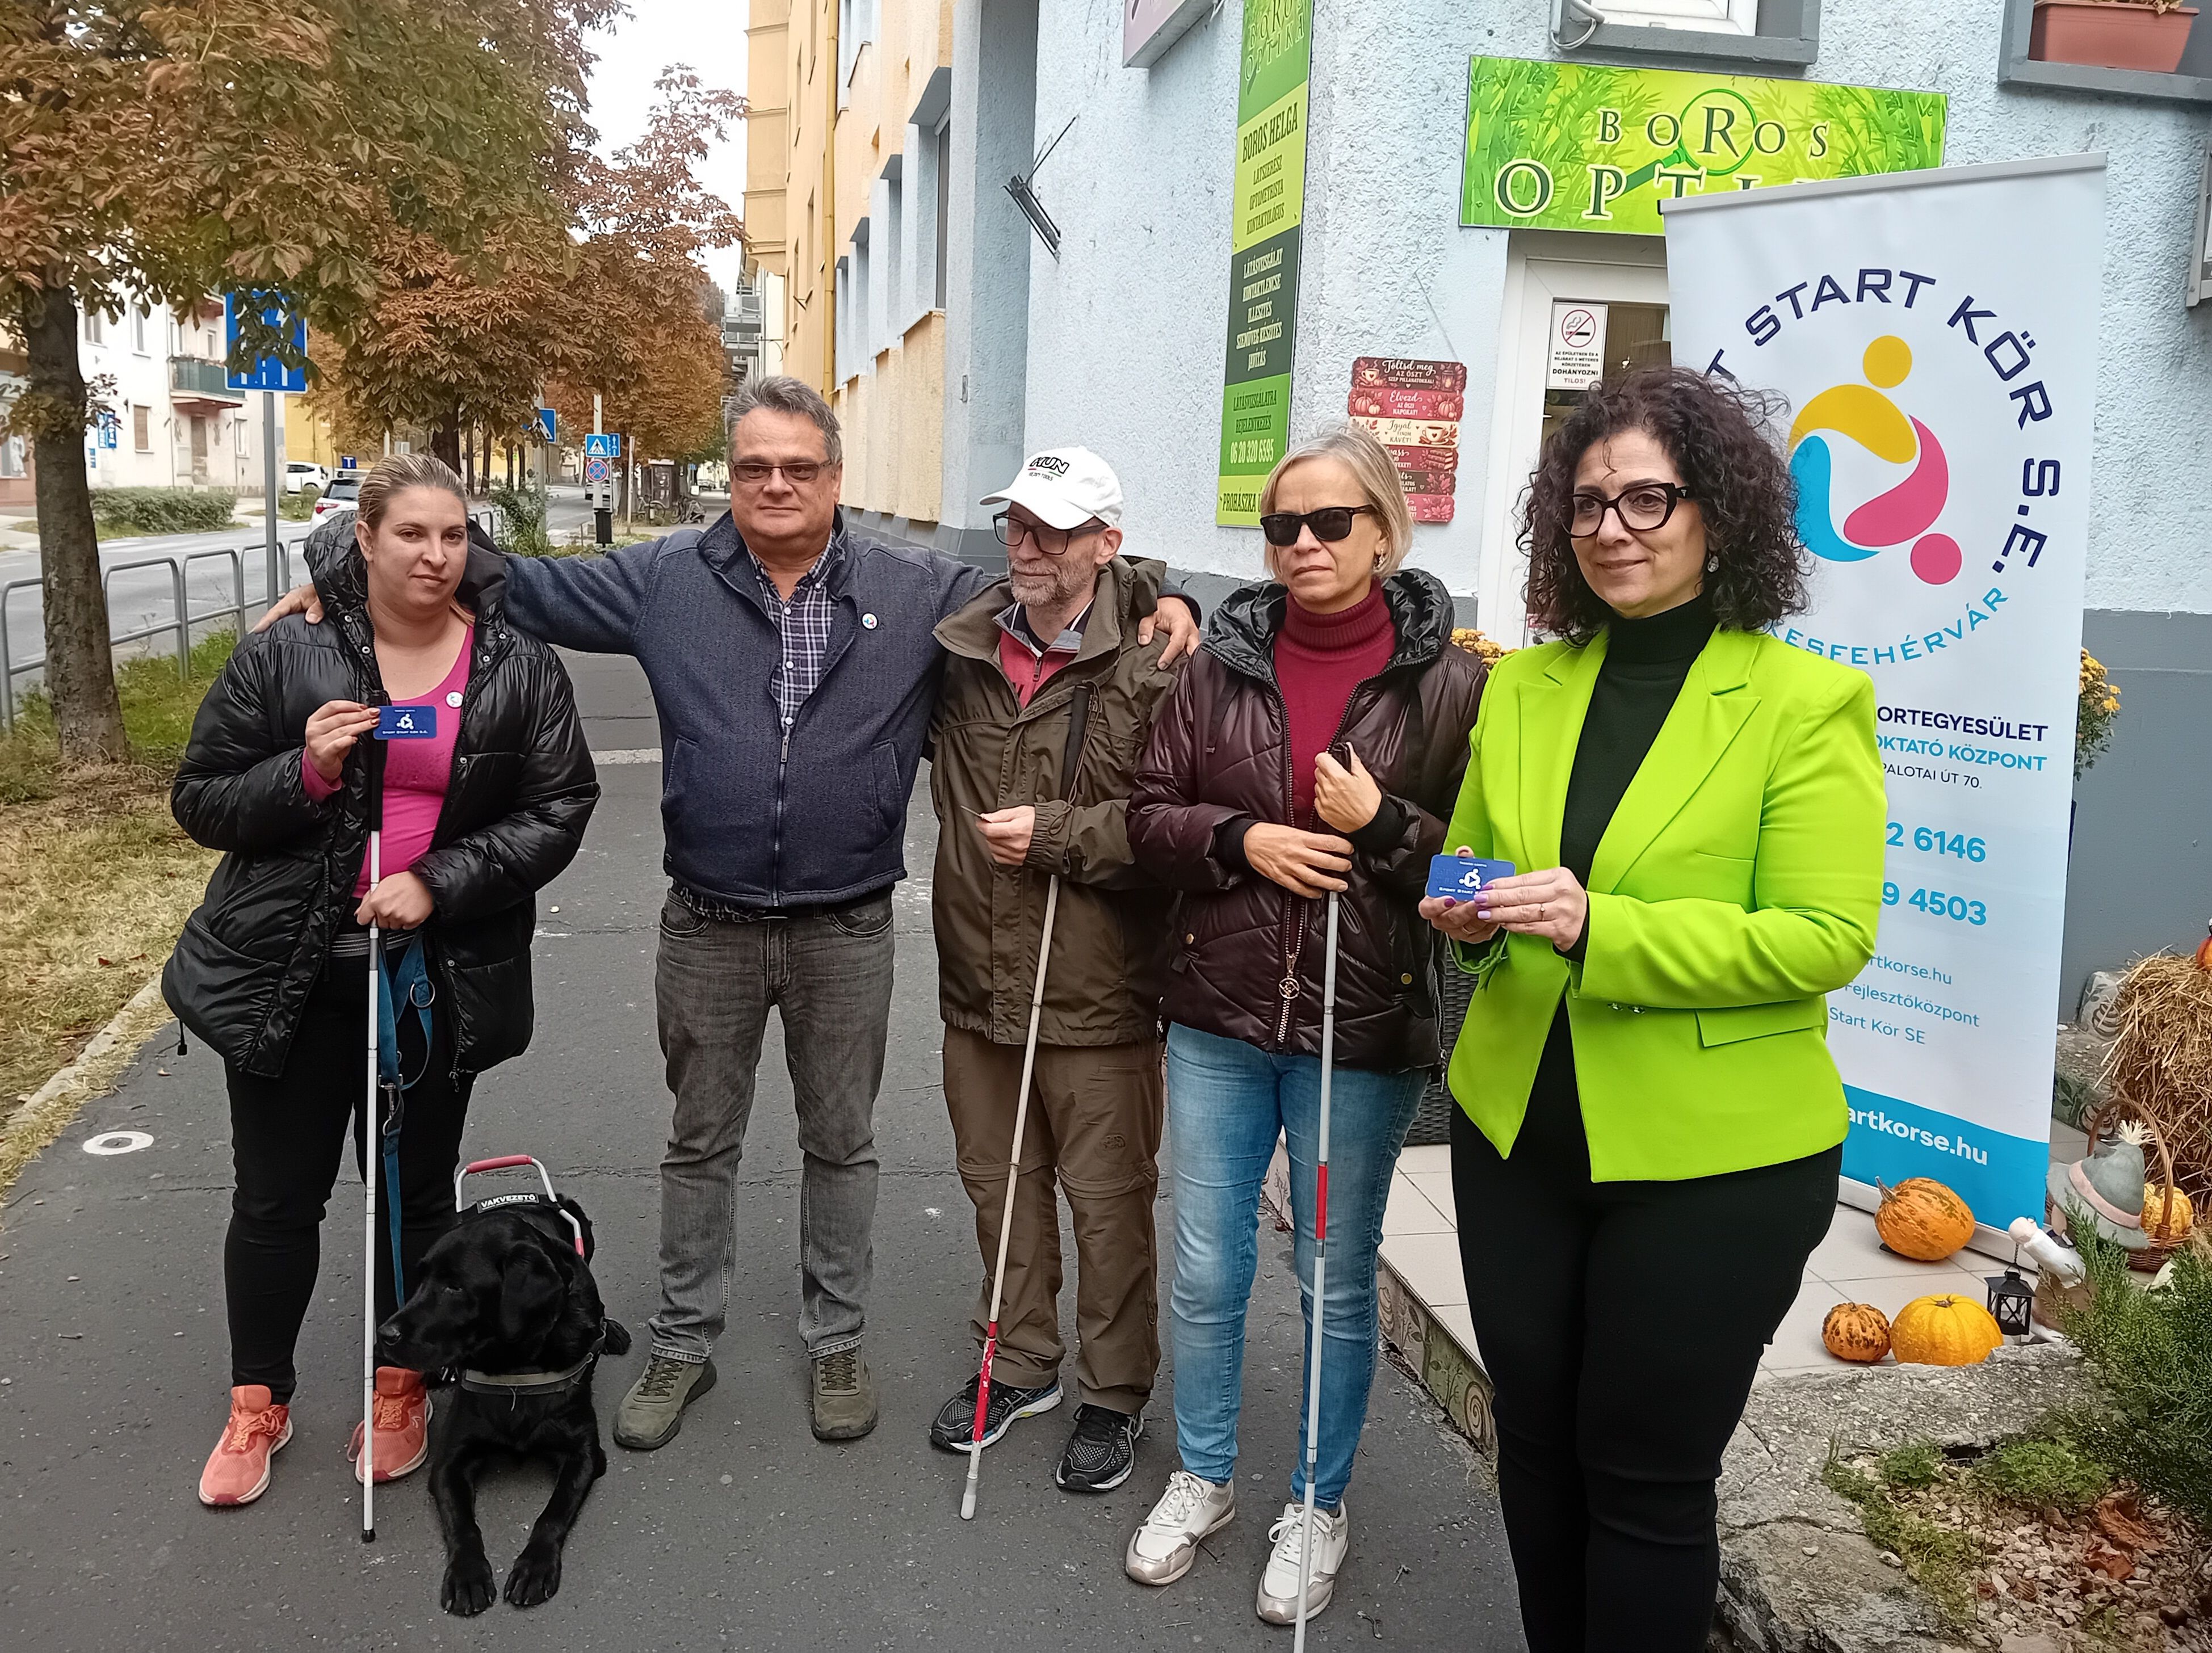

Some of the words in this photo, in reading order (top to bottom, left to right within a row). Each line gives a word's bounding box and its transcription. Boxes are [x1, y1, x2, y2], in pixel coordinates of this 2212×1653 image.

[1245, 12, 1304, 81] OPTIKA
[1242, 122, 1268, 163] BOROS
[1269, 102, 1298, 146] HELGA
[1596, 104, 1830, 159] BOROS
[1744, 268, 1937, 347] START
[1382, 360, 1415, 373] Töltsd
[1416, 364, 1437, 376] meg
[1947, 295, 2052, 431] KÖR
[343, 457, 354, 468] T
[1230, 441, 1238, 464] 06
[1238, 440, 1246, 463] 20
[1246, 440, 1258, 463] 320
[1258, 438, 1274, 462] 6595
[1222, 487, 1256, 512] PROHÁSZKA
[1992, 458, 2060, 573] S.E.
[1770, 587, 2008, 665] ESFEHÉRVÁR
[1949, 743, 2048, 771] KÖZPONT
[1941, 769, 1959, 784] ÚT
[1963, 775, 1983, 789] 70.
[1914, 827, 1986, 863] 6146
[1908, 888, 1987, 926] 4503
[1867, 956, 1952, 985] rtkorse.hu
[1829, 1007, 1866, 1029] Start
[1872, 1019, 1899, 1037] Kör
[1905, 1028, 1926, 1045] SE
[481, 1194, 536, 1208] VAKVEZETŐ
